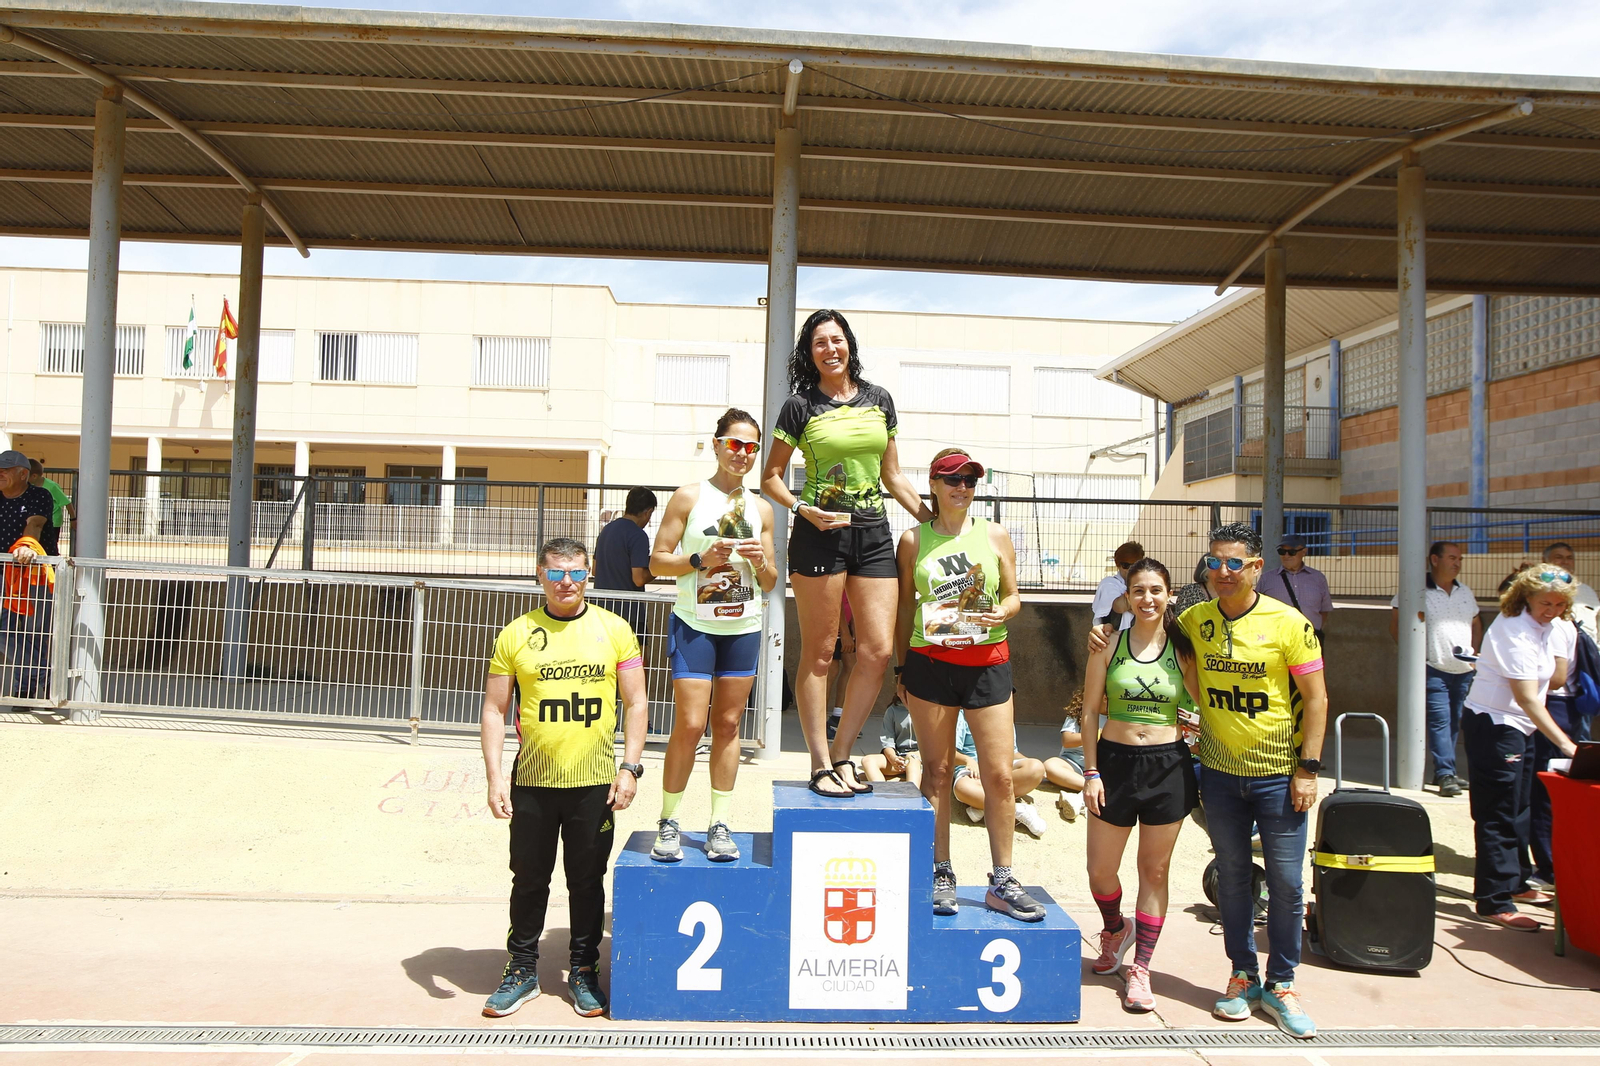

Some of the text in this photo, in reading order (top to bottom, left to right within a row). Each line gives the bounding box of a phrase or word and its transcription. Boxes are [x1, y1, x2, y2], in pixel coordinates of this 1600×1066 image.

[937, 552, 974, 576] XX
[718, 571, 731, 590] 5
[933, 582, 953, 596] MEDIO
[539, 664, 606, 680] SPORTGYM
[1204, 658, 1267, 674] SPORTGYM
[539, 692, 602, 728] mtp
[1207, 685, 1269, 719] mtp
[676, 901, 723, 991] 2
[797, 954, 900, 978] ALMERÍA
[976, 938, 1022, 1013] 3
[821, 980, 876, 992] CIUDAD
